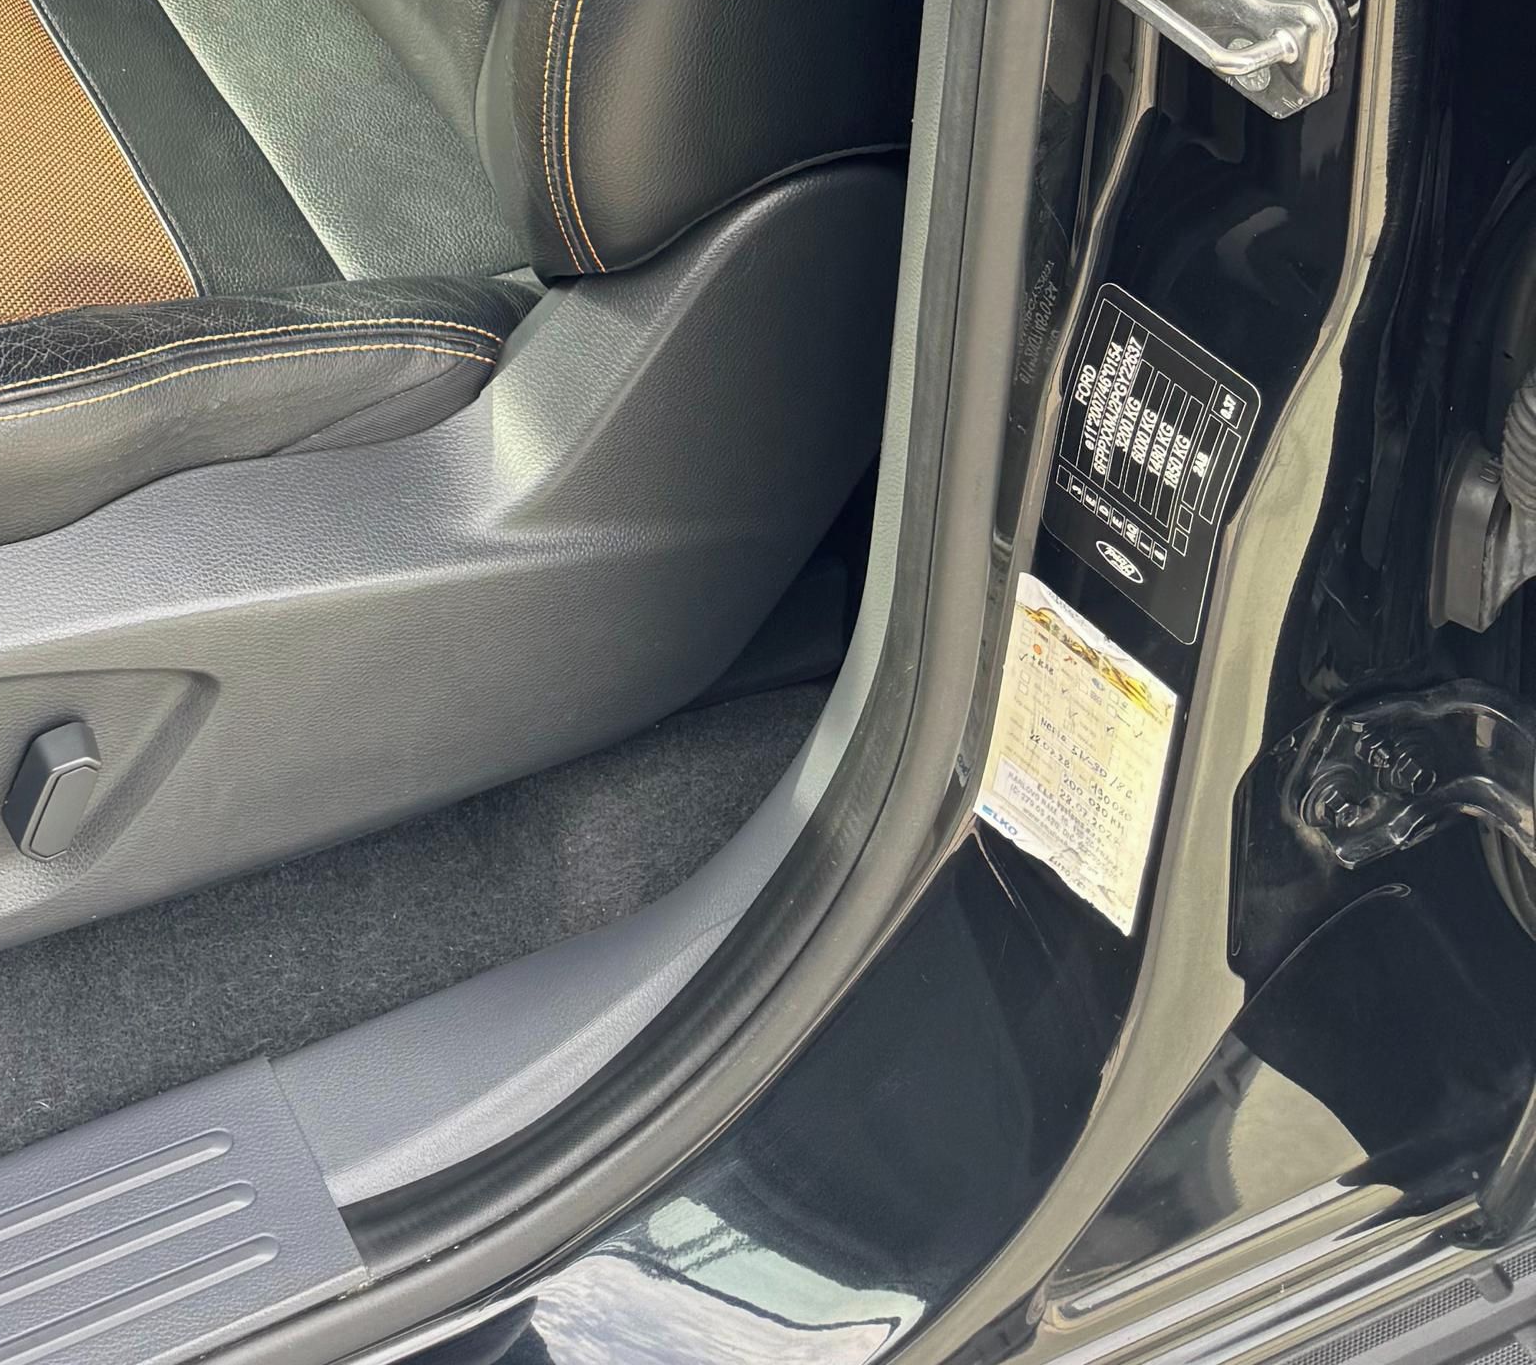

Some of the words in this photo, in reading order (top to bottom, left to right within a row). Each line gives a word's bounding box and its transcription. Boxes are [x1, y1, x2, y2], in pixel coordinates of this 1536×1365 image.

[1074, 364, 1097, 404] FORD
[1093, 337, 1143, 474] 6FPPXXMJ2PGY22637
[1123, 396, 1141, 420] KG
[1139, 409, 1157, 433] KG
[1115, 419, 1136, 452] 3200
[1131, 432, 1152, 465] 6000
[1155, 421, 1175, 446] KG
[1171, 434, 1190, 459] KG
[1148, 444, 1168, 476] 1480
[1164, 457, 1184, 488] 1850
[1193, 452, 1209, 477] 2AB
